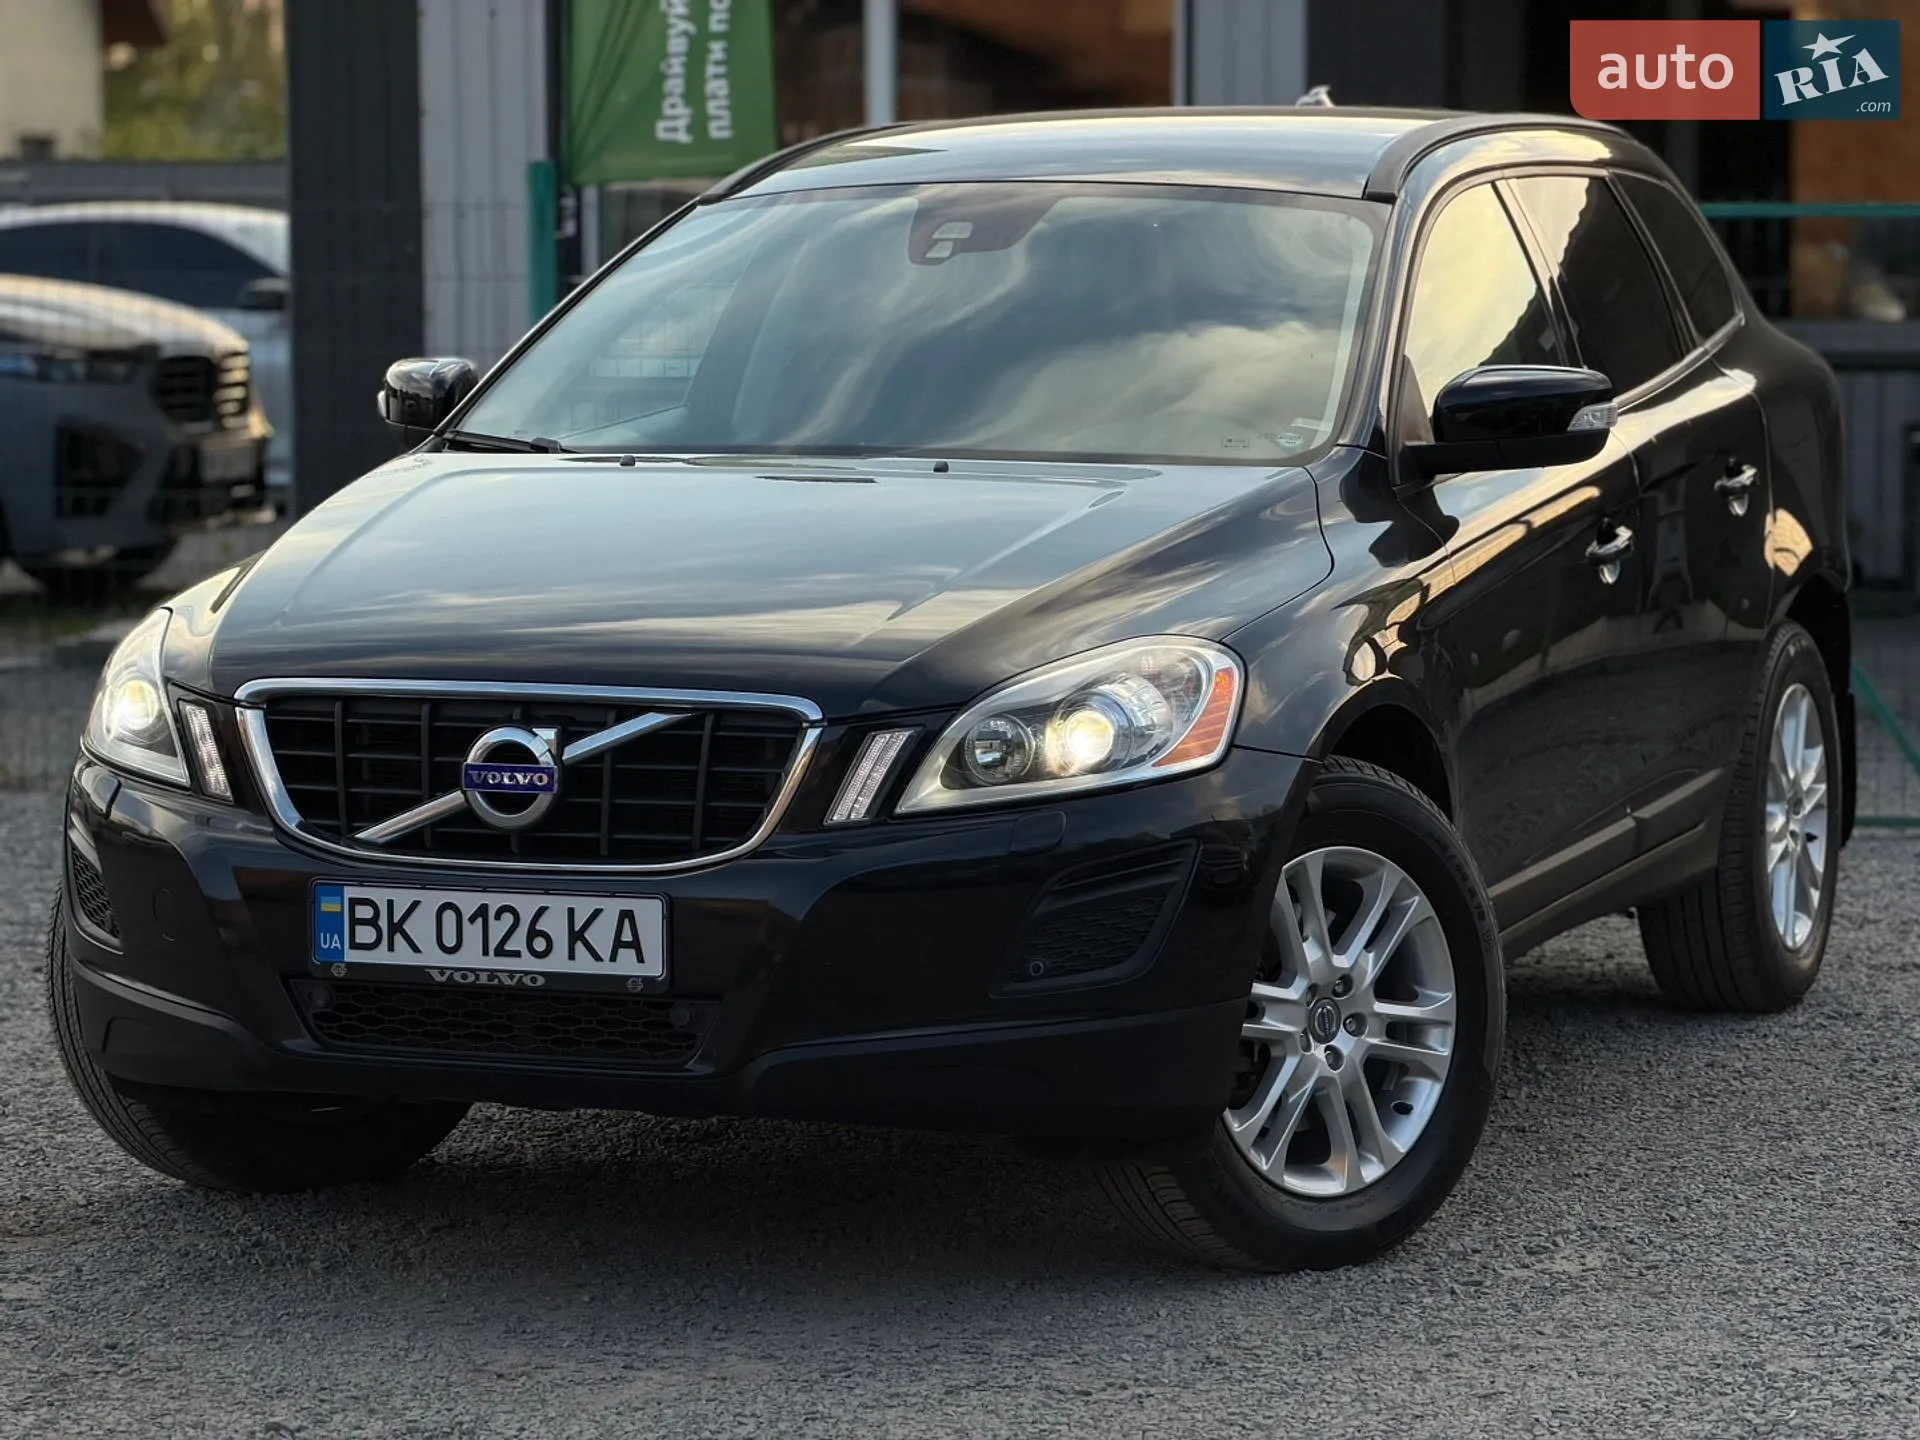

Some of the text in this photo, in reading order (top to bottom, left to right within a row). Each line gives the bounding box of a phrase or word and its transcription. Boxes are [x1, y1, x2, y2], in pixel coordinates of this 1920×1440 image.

[703, 40, 734, 140] плати
[468, 770, 549, 786] VOLVO
[348, 896, 645, 964] BK 0126 KA
[320, 932, 342, 950] UA
[425, 968, 546, 987] VOLVO
